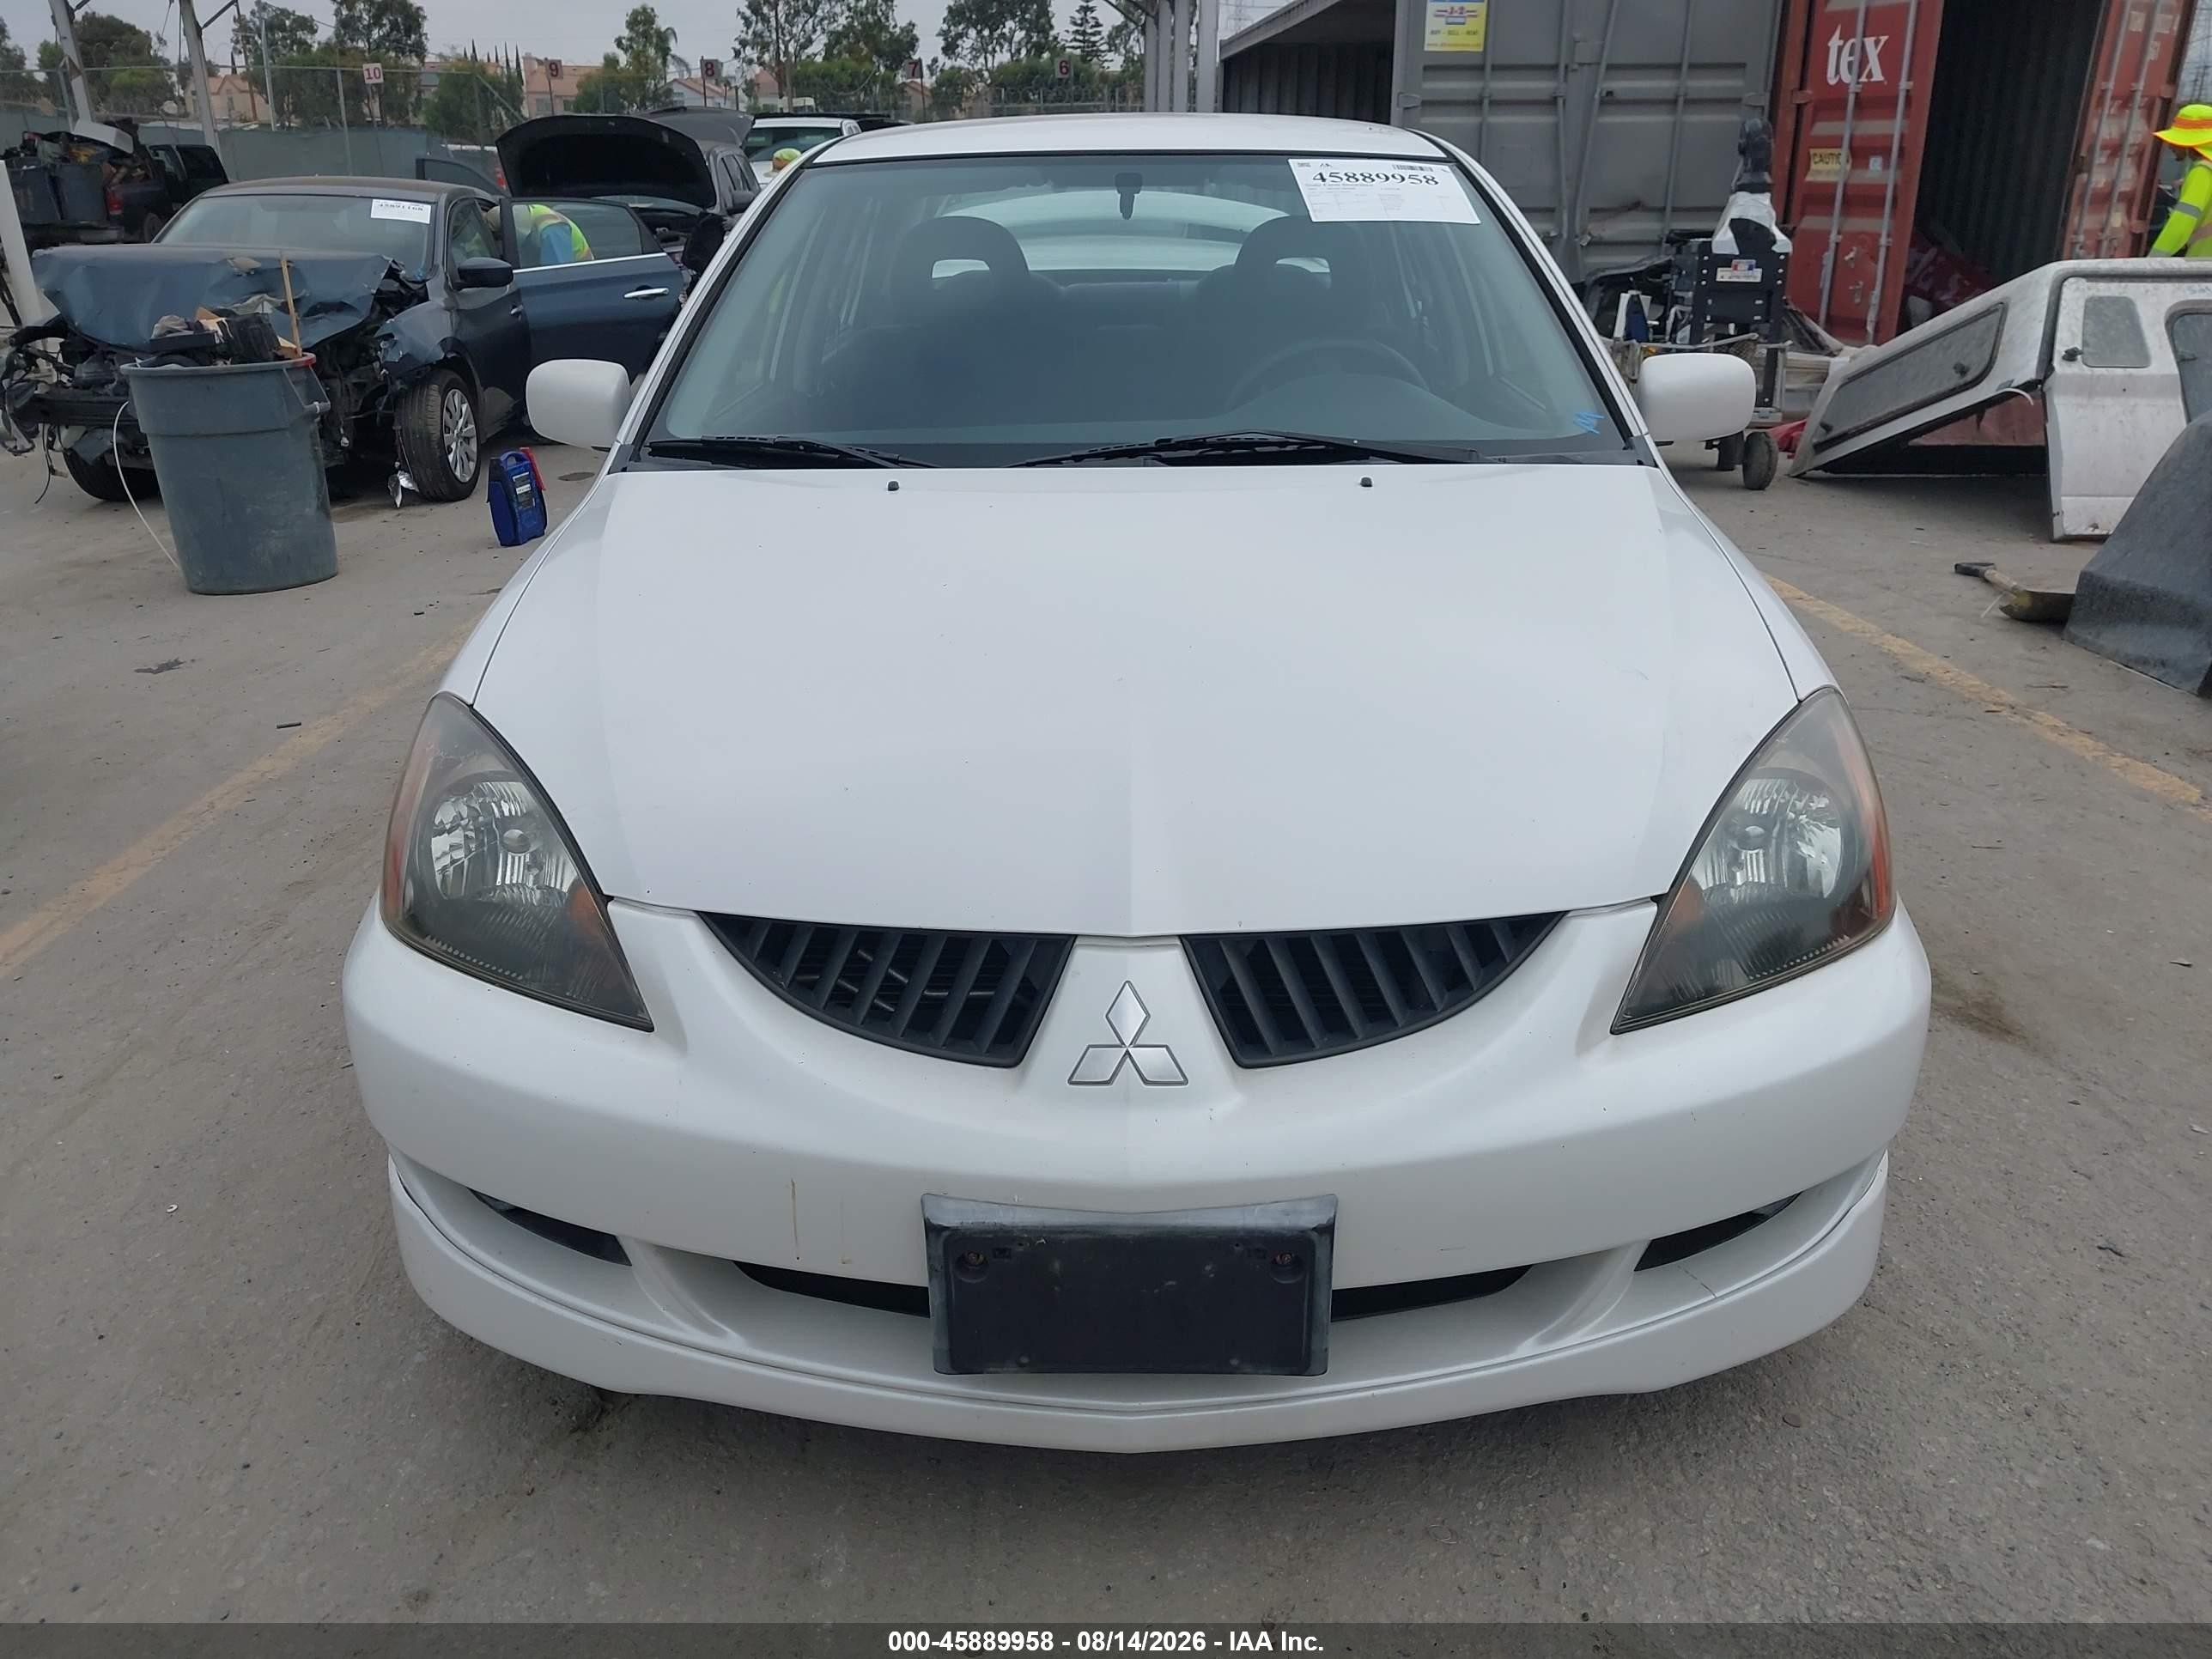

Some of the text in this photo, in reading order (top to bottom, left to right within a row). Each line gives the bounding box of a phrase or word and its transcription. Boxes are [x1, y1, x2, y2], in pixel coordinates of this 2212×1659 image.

[1826, 23, 1889, 86] tex
[364, 67, 381, 80] 10
[549, 62, 558, 77] 9
[704, 61, 714, 77] 8
[908, 61, 919, 77] 7
[1059, 60, 1069, 76] 6
[1311, 171, 1440, 186] 45889958
